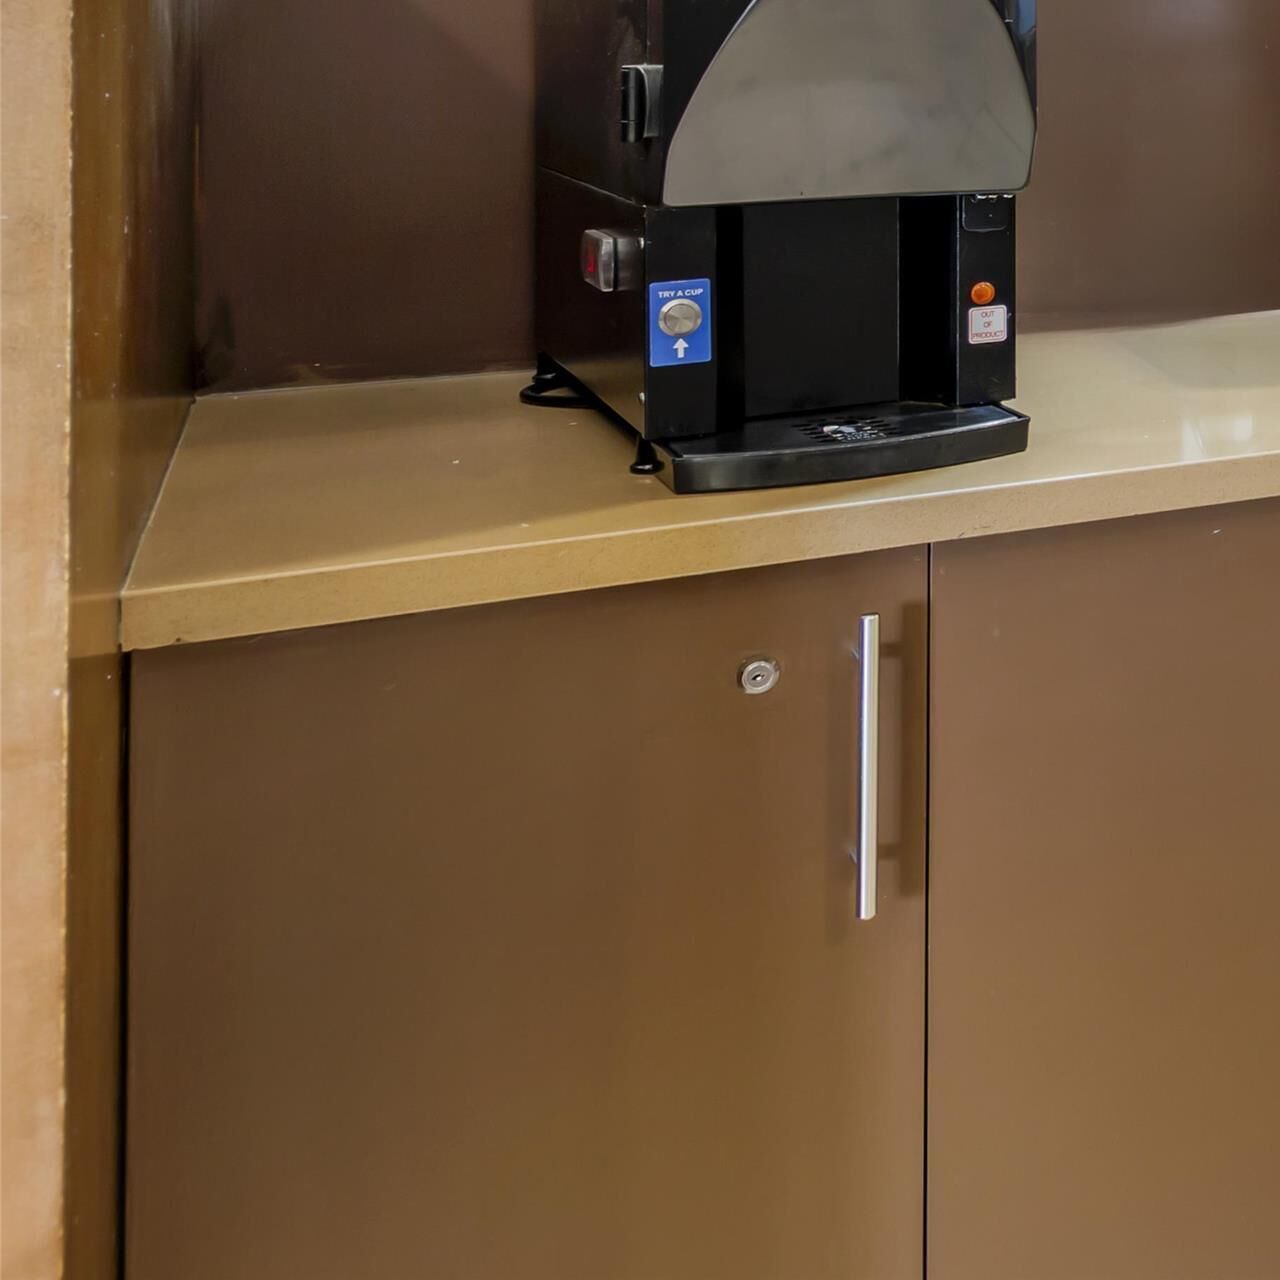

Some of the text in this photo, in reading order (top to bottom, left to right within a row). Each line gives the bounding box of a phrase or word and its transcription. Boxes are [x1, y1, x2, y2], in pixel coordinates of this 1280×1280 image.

[658, 288, 704, 298] TRY A CUP
[972, 330, 1003, 339] PRODUCT
